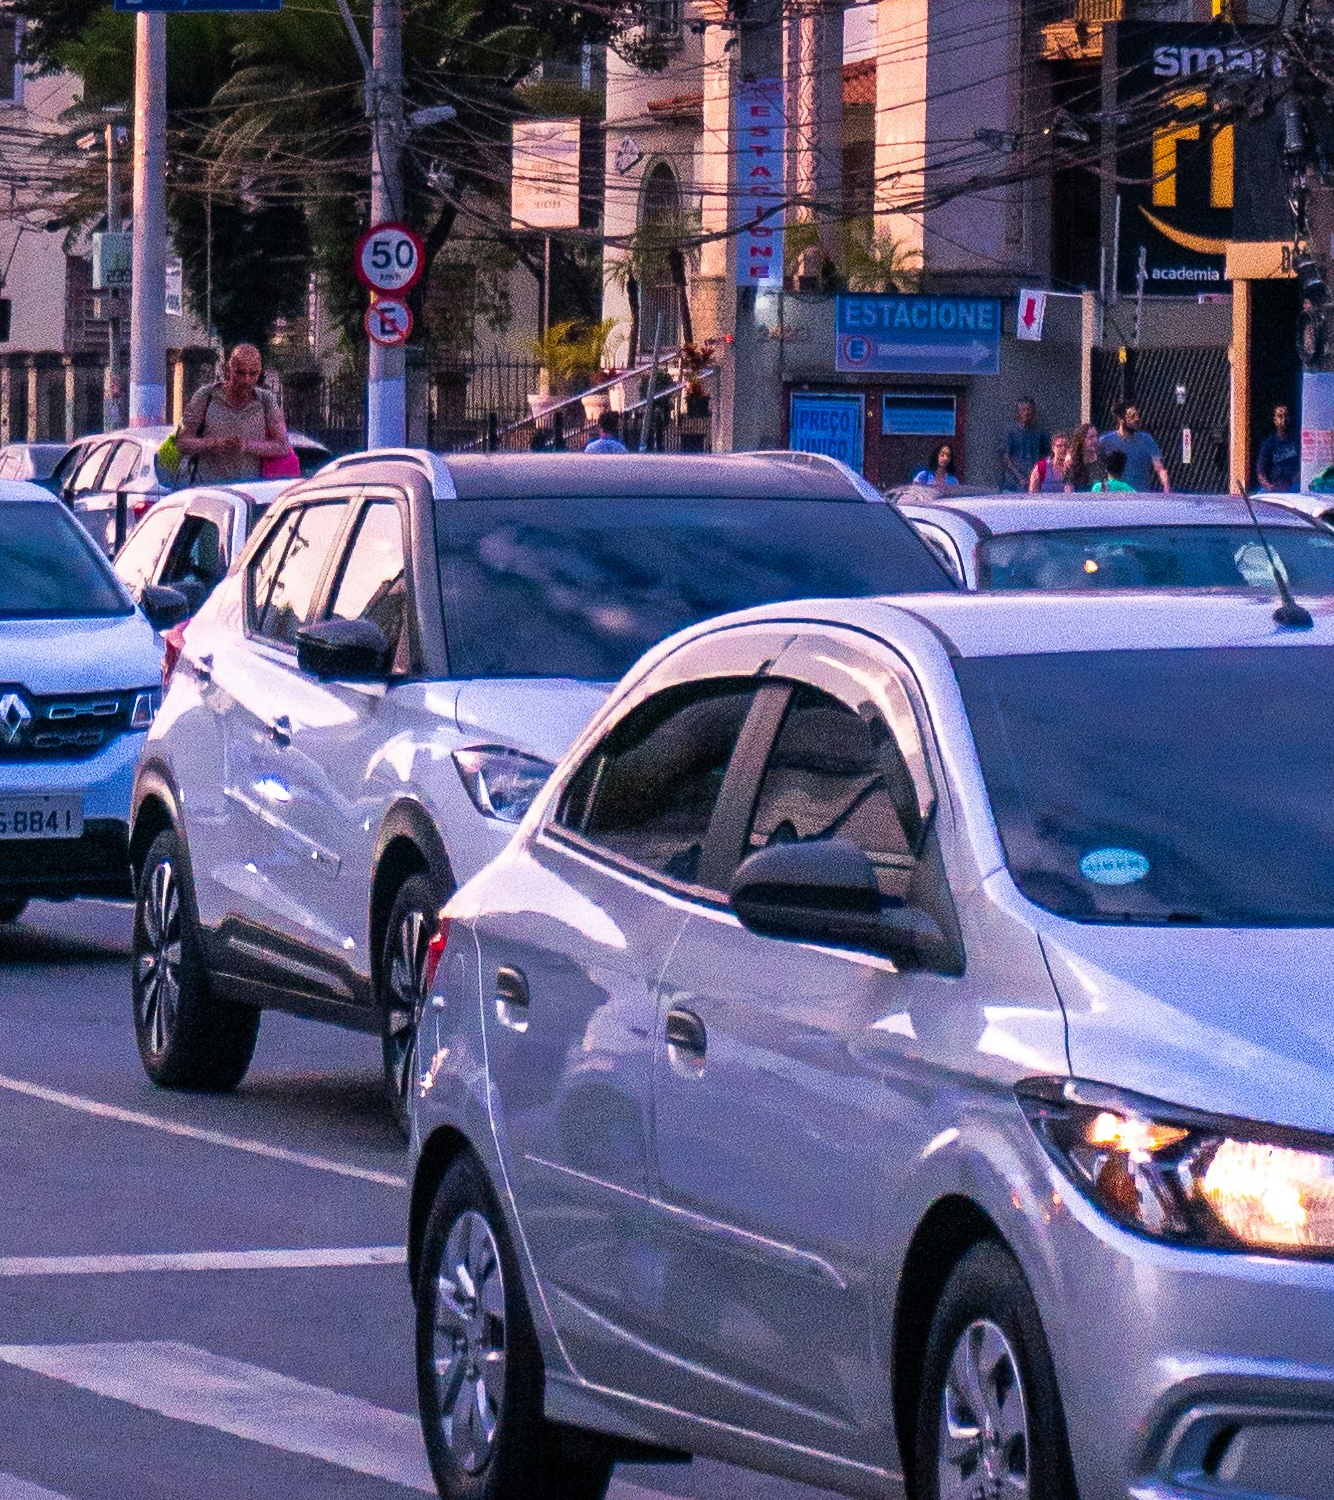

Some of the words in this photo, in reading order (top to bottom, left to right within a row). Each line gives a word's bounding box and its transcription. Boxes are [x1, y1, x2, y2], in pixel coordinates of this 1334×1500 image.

[371, 240, 414, 269] 50
[1152, 265, 1220, 281] academia
[844, 299, 995, 331] ESTACIONE
[799, 410, 851, 436] PREÇO
